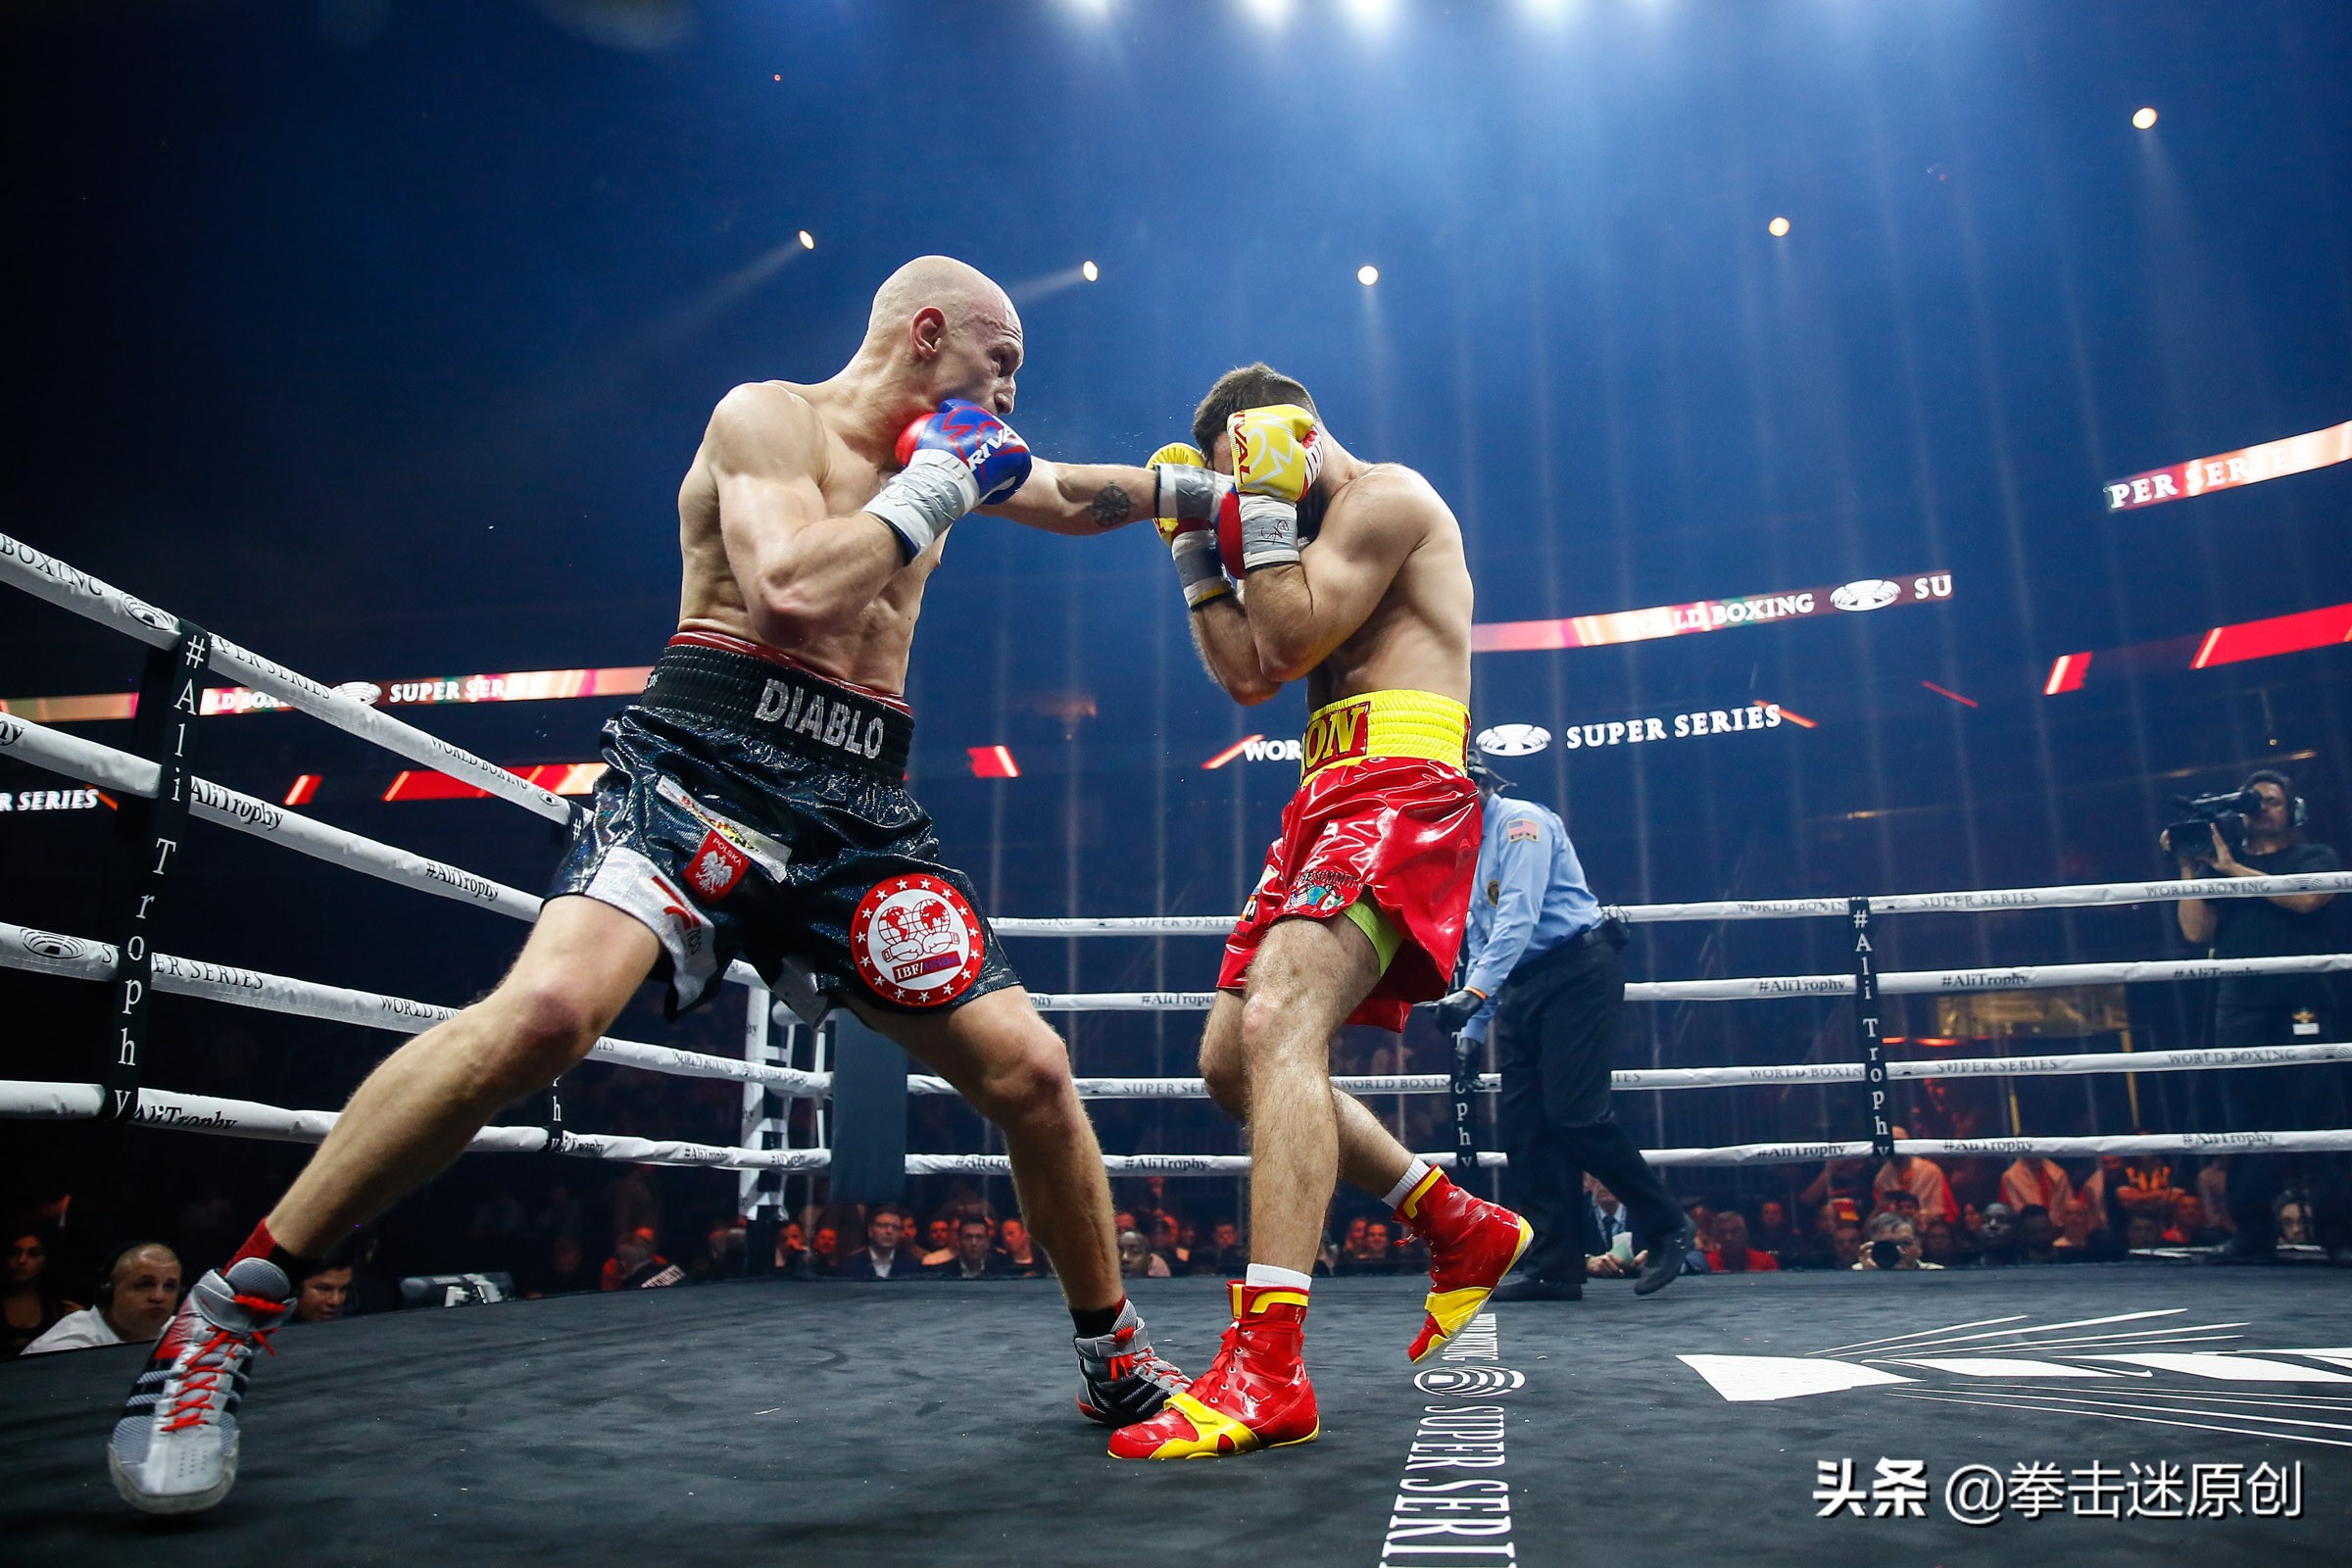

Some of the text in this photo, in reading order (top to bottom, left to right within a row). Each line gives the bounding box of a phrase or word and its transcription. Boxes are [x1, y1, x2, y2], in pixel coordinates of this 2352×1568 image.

[966, 427, 1016, 471] RIVA
[2107, 474, 2180, 509] PER
[0, 536, 103, 596] BOXING
[1711, 593, 1815, 625] BOXING
[218, 637, 262, 669] PER
[388, 683, 461, 703] SUPER
[754, 678, 884, 760] DIABLO
[1566, 705, 1782, 750] SUPER SERIES
[1243, 740, 1301, 761] WOR
[1304, 707, 1365, 769] ON
[18, 788, 99, 811] SERIES
[191, 780, 284, 832] AliTrophy
[712, 837, 743, 868] POLSKA
[2144, 885, 2202, 899] WORLD
[2207, 881, 2272, 896] BOXING
[1798, 900, 1848, 912] BOXIN
[190, 959, 264, 990] SERIES
[379, 996, 433, 1019] WORLD
[1811, 1065, 1863, 1079] BOXIN
[2168, 1049, 2297, 1065] WORLD BOXING
[1123, 1083, 1176, 1094] SUPER
[1340, 1078, 1396, 1090] WORLD
[133, 1105, 237, 1130] AliTrophy
[1378, 1405, 1518, 1568] SUPER SERI
